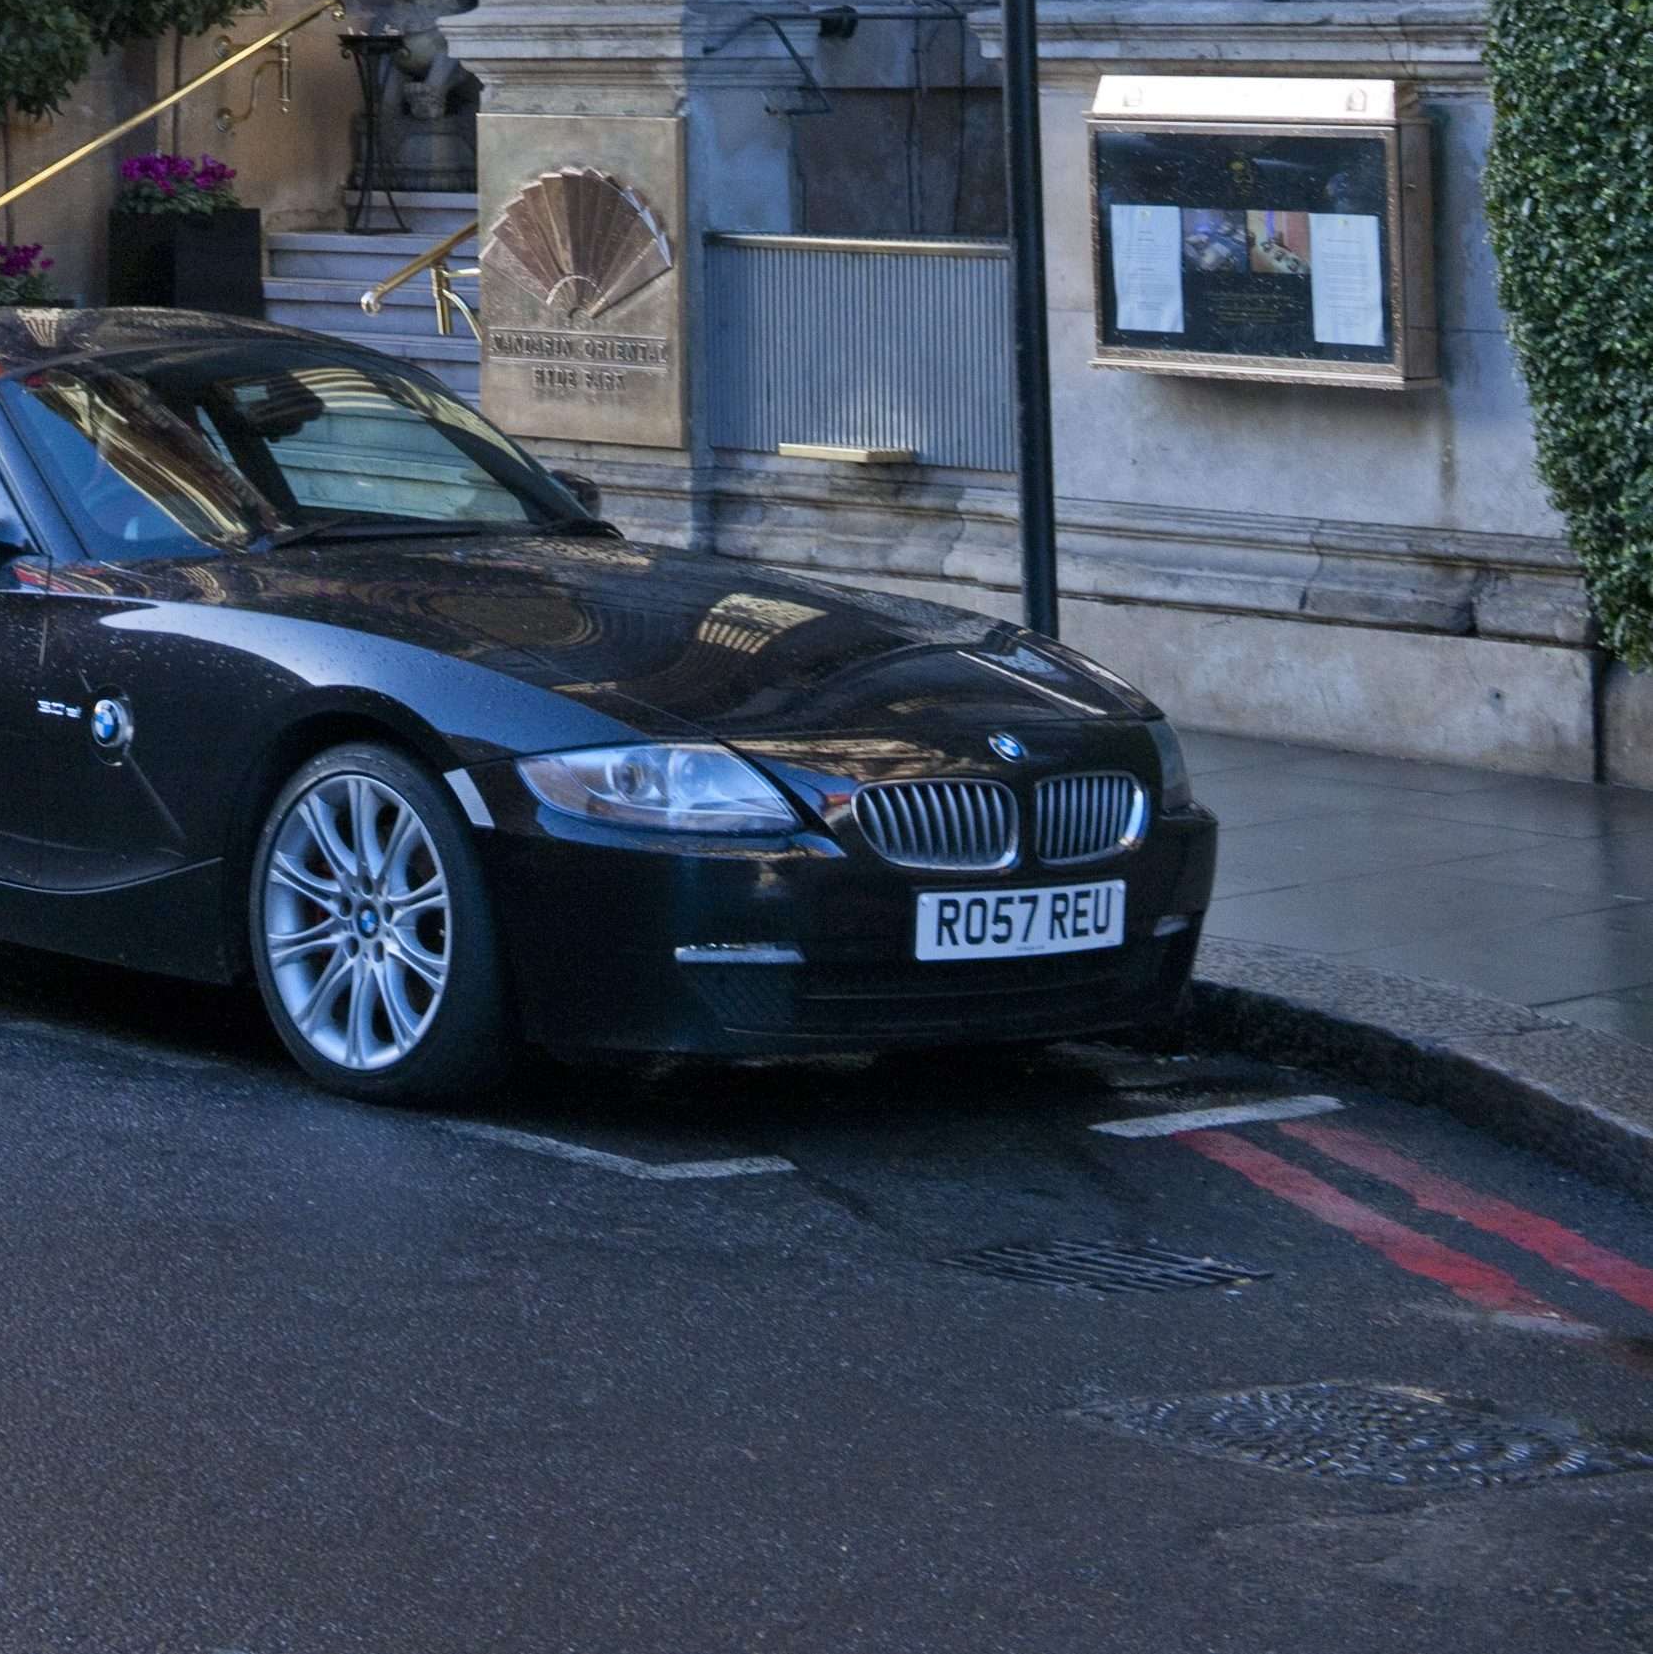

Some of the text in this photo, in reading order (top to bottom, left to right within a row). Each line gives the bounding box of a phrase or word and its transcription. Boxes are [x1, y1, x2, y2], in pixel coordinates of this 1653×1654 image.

[488, 333, 667, 363] MANDARIN ORIENTAL
[531, 367, 626, 391] HYDE PARK
[935, 887, 1112, 947] RO57 REU
